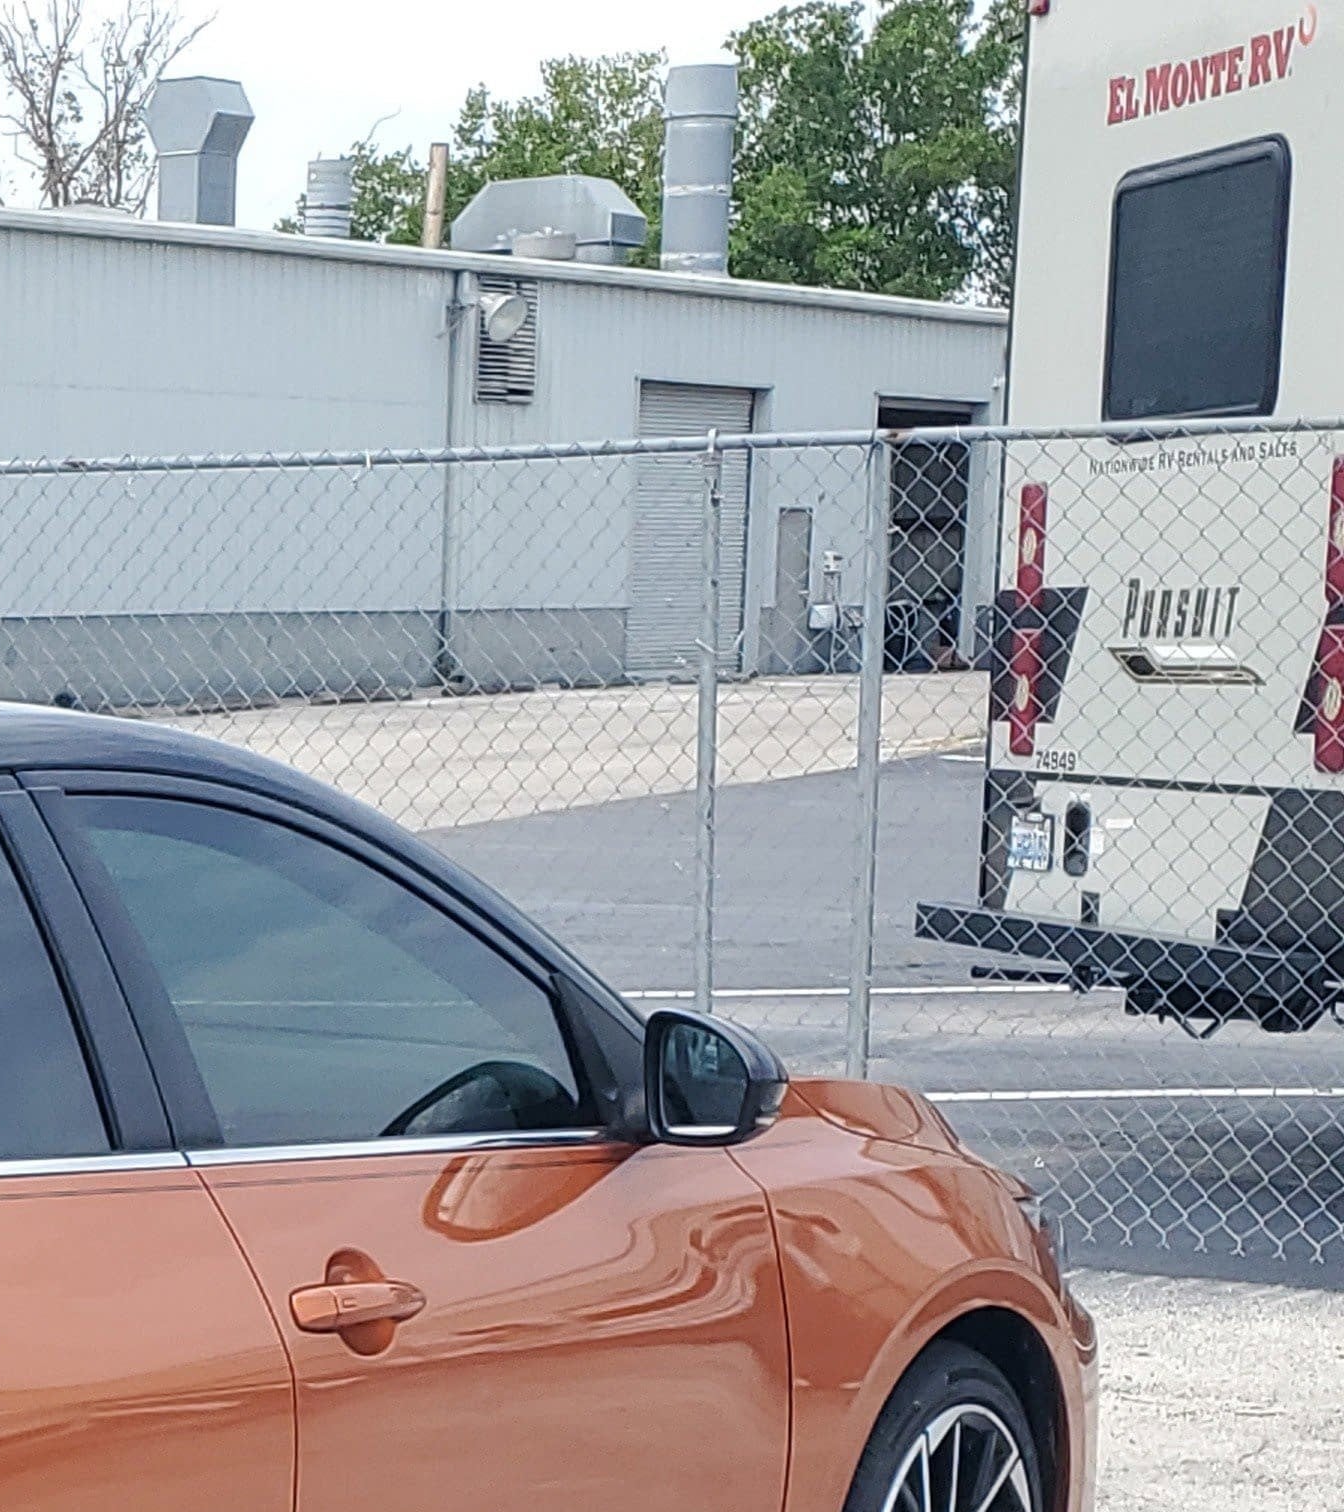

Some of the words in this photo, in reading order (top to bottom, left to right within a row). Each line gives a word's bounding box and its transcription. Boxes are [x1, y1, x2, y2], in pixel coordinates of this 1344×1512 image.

[1107, 76, 1139, 126] EL
[1143, 46, 1245, 117] MONTE
[1248, 26, 1295, 87] RV
[1231, 445, 1256, 462] AND
[1122, 578, 1240, 638] PURSUIT
[1035, 750, 1076, 771] 74949
